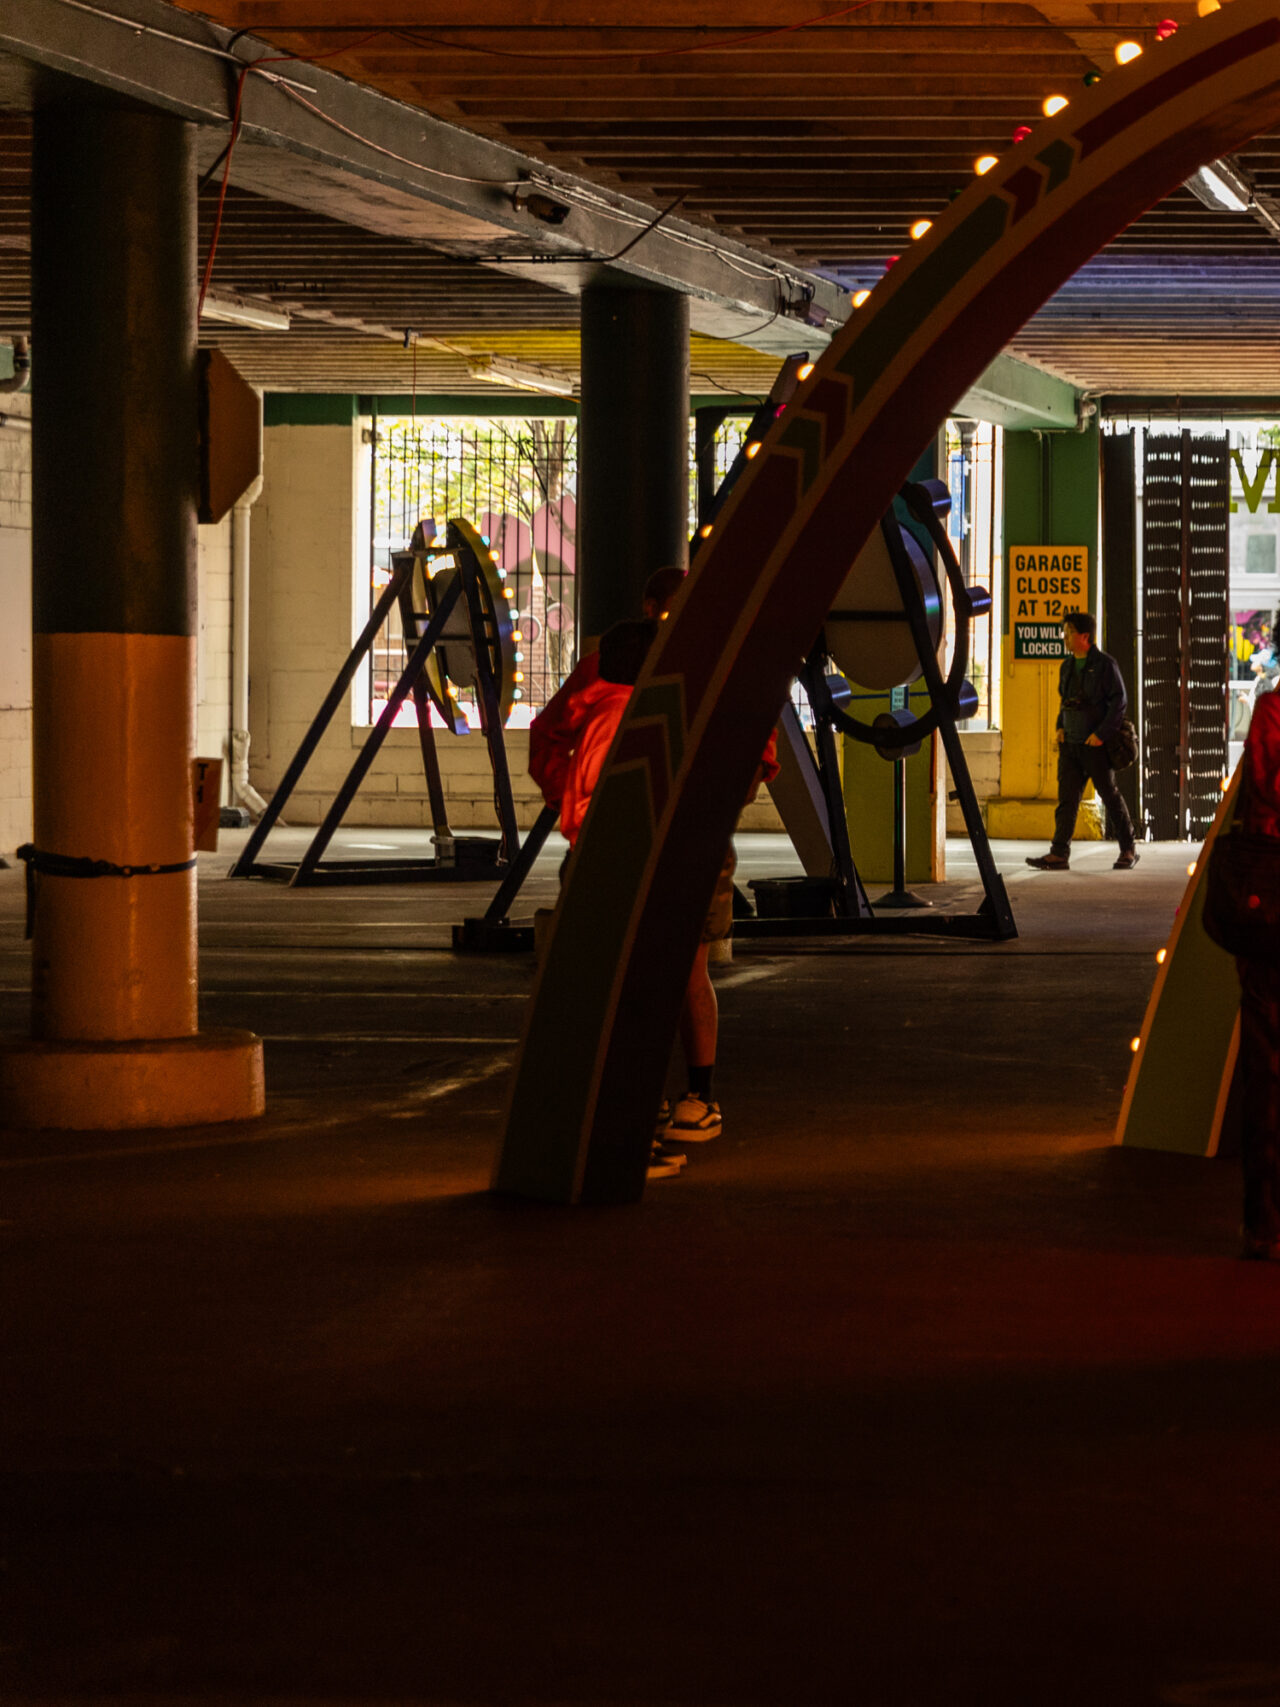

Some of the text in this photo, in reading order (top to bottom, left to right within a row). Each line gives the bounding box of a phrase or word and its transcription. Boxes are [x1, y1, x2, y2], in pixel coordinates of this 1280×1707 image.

[1016, 555, 1082, 571] GARAGE
[1017, 578, 1081, 594] CLOSES
[1017, 600, 1038, 616] AT
[1017, 626, 1038, 639] YOU
[1022, 642, 1062, 655] LOCKED
